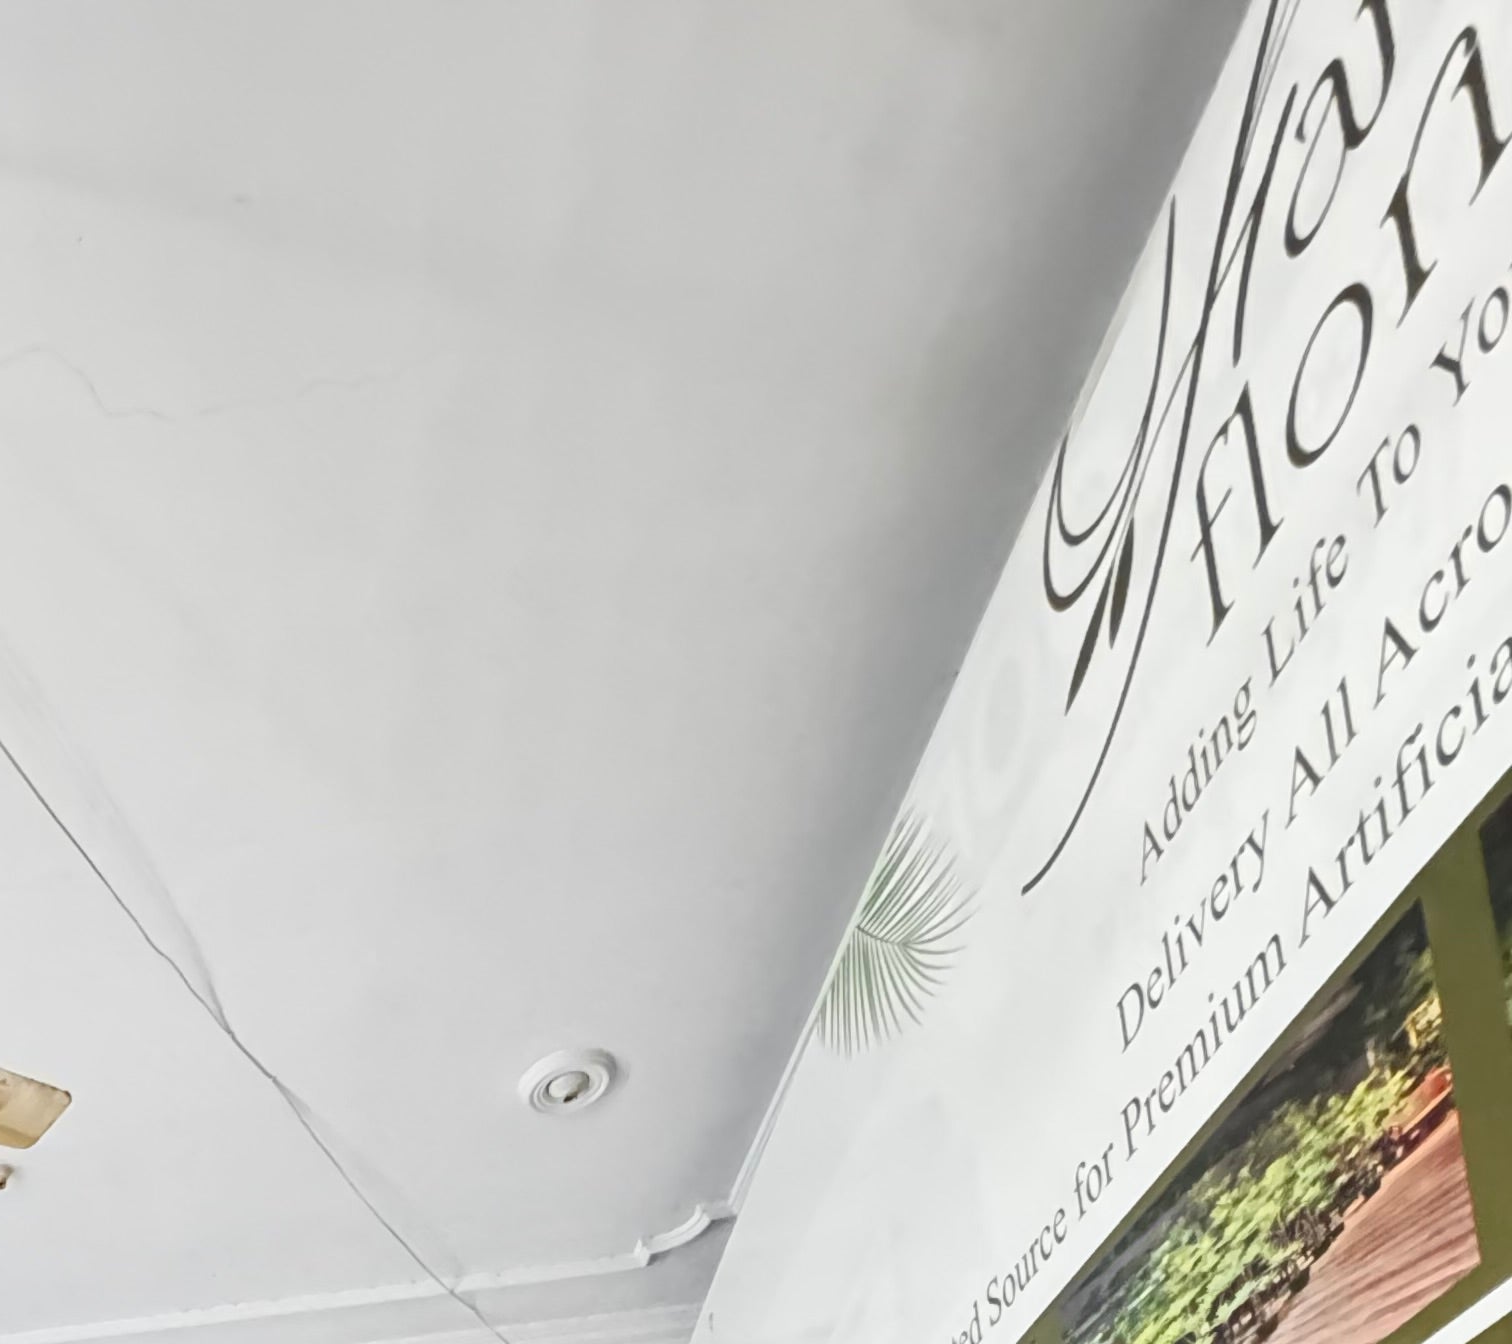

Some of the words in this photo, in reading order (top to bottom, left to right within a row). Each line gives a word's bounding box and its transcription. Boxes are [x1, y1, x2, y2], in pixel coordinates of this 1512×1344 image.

[1115, 808, 1270, 1055] Delivery
[1285, 676, 1358, 829] All
[1373, 483, 1512, 709] Acro
[1139, 677, 1258, 887] Adding
[1261, 533, 1349, 688] Life
[1357, 423, 1420, 529] To
[1428, 262, 1512, 408] Yo
[986, 1206, 1069, 1327] Source
[1073, 1142, 1115, 1221] for
[1120, 933, 1288, 1162] Premium
